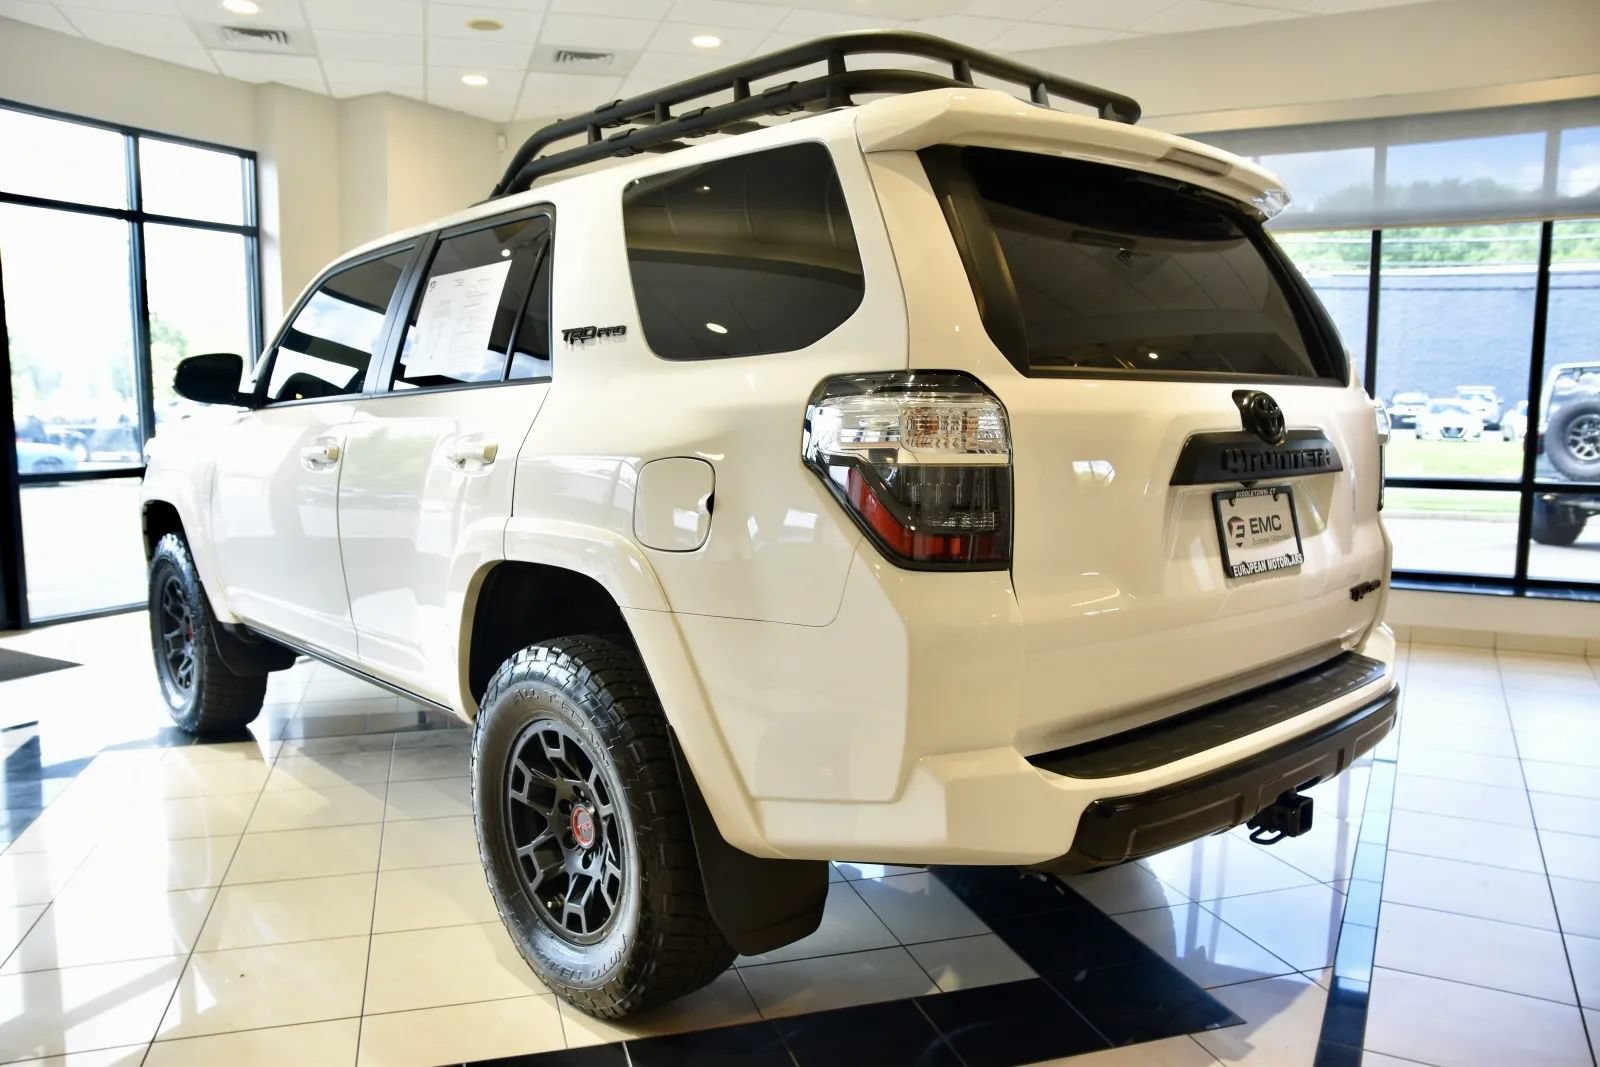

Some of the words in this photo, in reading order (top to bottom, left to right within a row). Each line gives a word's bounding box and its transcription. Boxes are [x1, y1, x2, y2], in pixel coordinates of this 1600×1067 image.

[562, 326, 597, 344] TRD
[597, 325, 626, 337] PRO
[1249, 515, 1282, 535] EMC
